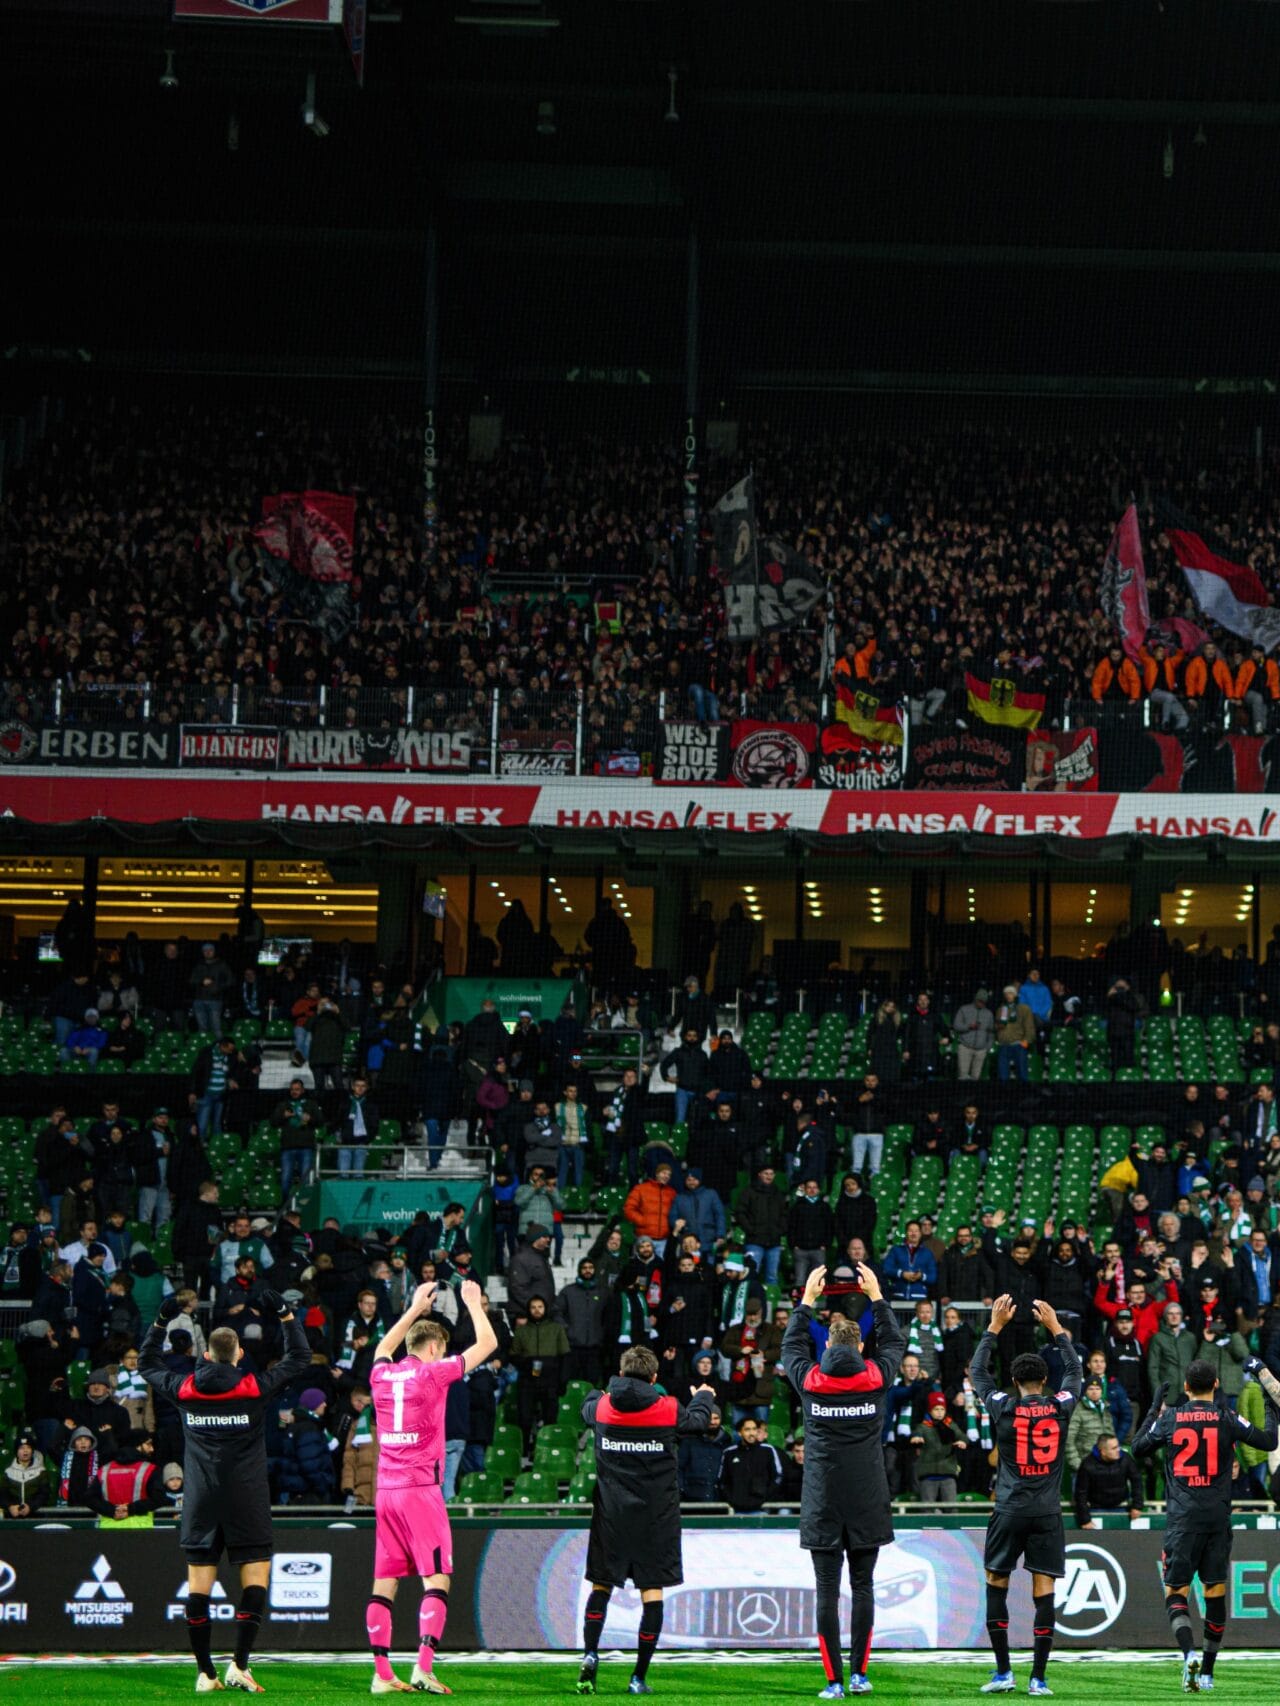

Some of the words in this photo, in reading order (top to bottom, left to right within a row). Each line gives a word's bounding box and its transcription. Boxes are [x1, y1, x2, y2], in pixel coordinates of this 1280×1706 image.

[684, 417, 697, 470] 107
[40, 728, 168, 761] ERBEN
[664, 724, 721, 745] WEST
[183, 735, 277, 760] DJANGOS
[286, 729, 363, 766] NORD
[664, 745, 718, 766] SIDE
[662, 765, 717, 781] BOYZ
[819, 764, 901, 790] Brothers
[261, 803, 383, 826] HANSA
[413, 805, 505, 827] FLEX
[556, 809, 677, 831] HANSA
[707, 811, 793, 832] FLEX
[847, 811, 966, 834] HANSA
[995, 812, 1082, 836] FLEX
[1136, 815, 1254, 837] HANSA
[392, 1381, 405, 1432] 1
[811, 1402, 876, 1417] Barmenia
[186, 1412, 249, 1426] Barmenia
[601, 1437, 664, 1453] Barmenia
[1012, 1417, 1061, 1466] 19
[1172, 1427, 1219, 1477] 21
[1018, 1465, 1050, 1477] TELLA
[1187, 1475, 1211, 1487] ADLI
[286, 1562, 318, 1575] Ford
[282, 1589, 320, 1600] TRUCKS
[65, 1602, 133, 1614] MITSUBISHI
[166, 1604, 235, 1620] FSO
[270, 1612, 299, 1622] Sharing
[301, 1612, 311, 1621] the
[312, 1612, 329, 1621] load
[74, 1613, 124, 1625] MOTORS
